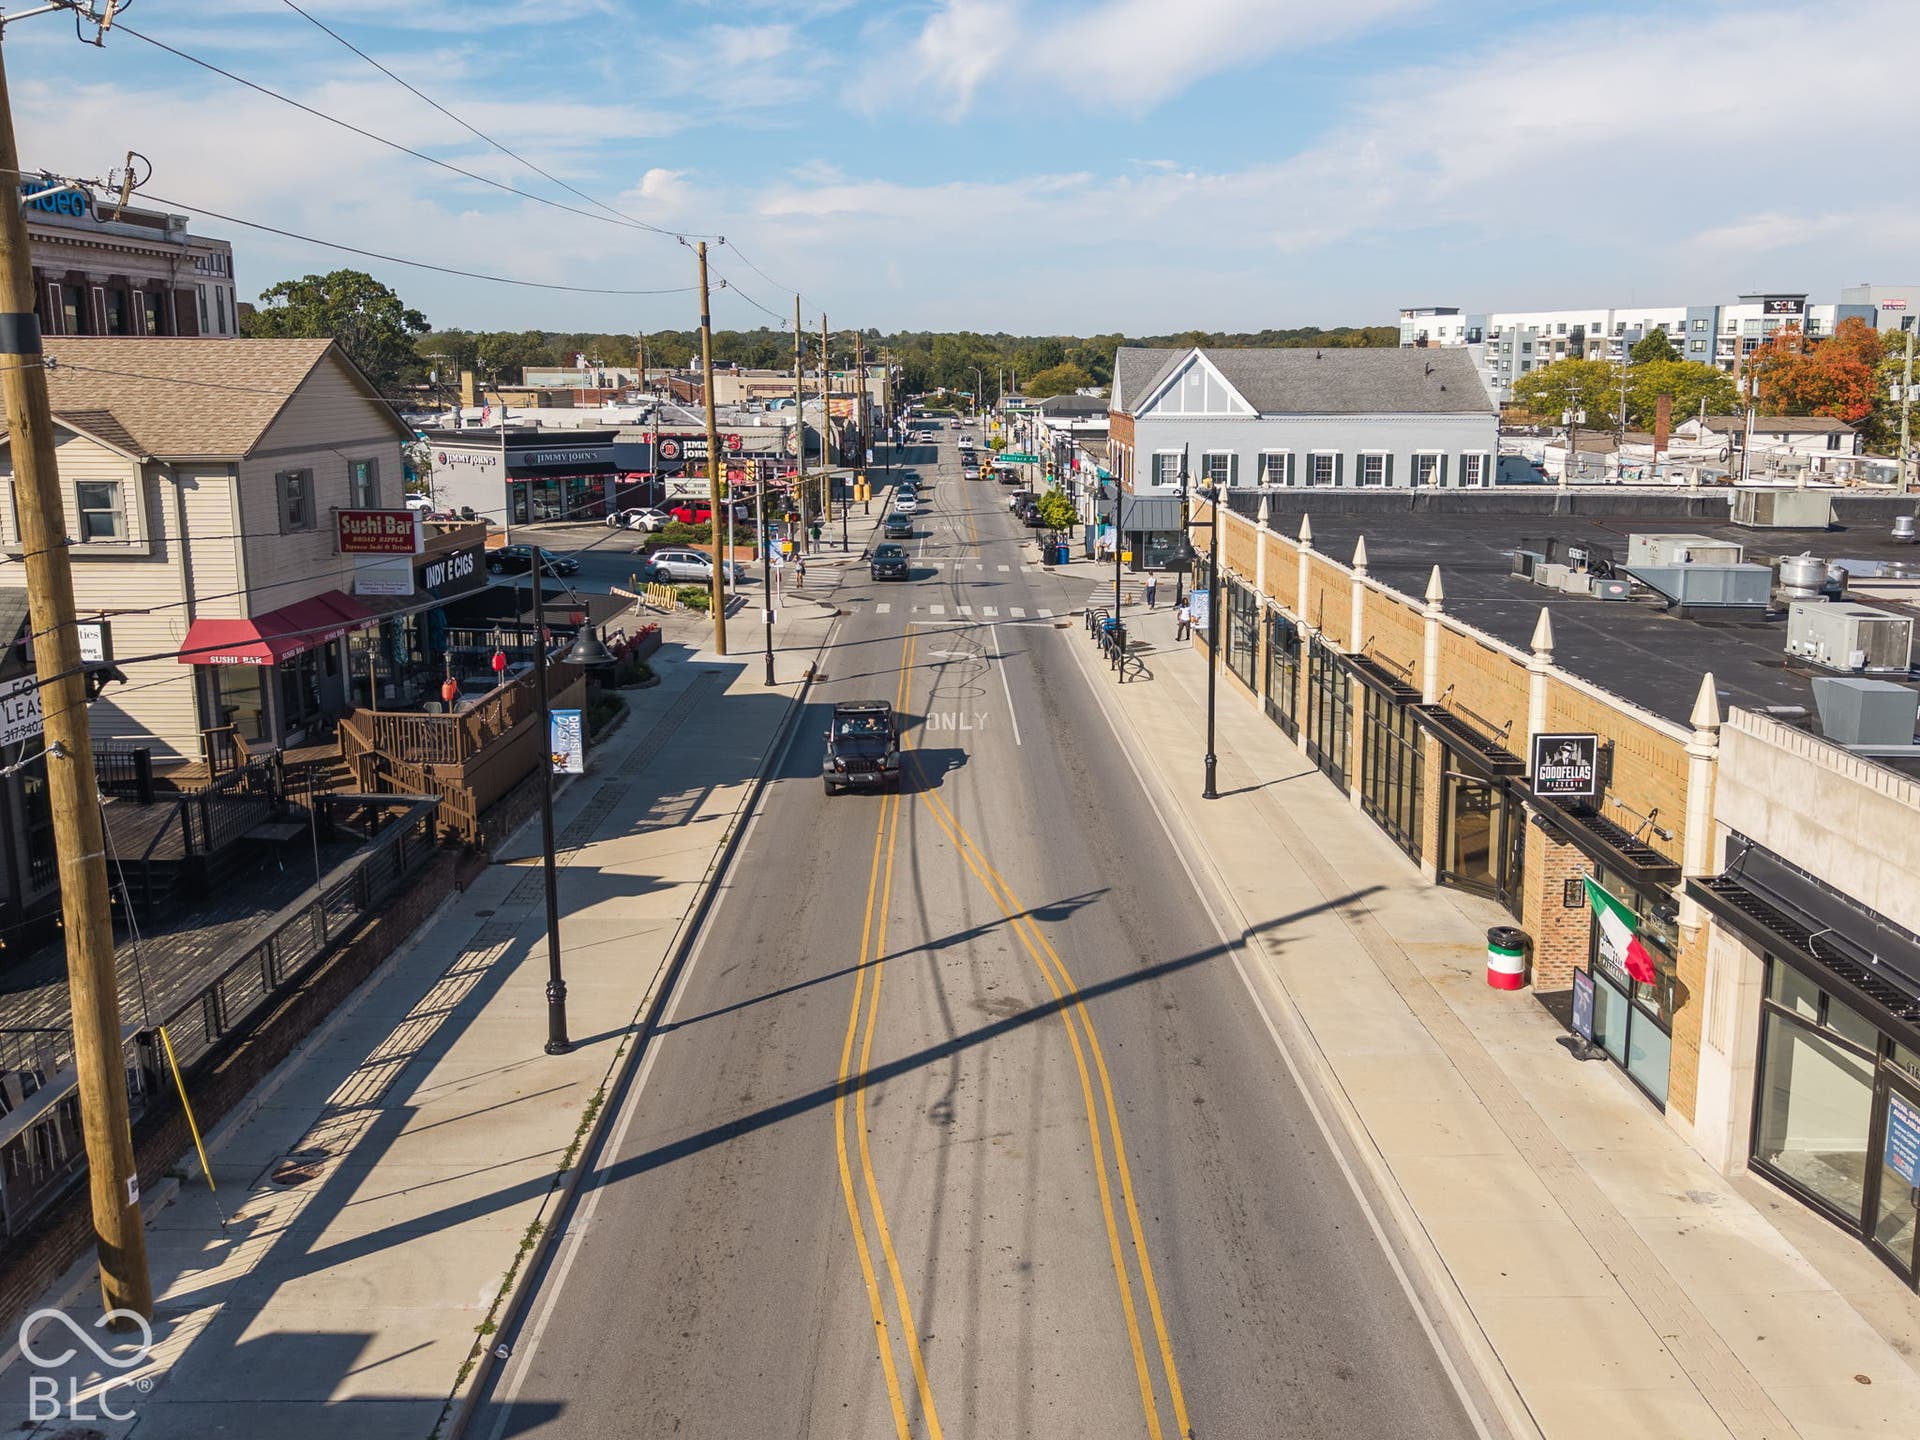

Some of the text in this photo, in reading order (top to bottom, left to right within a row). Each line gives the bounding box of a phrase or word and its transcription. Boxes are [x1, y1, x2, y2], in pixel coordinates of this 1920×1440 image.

[683, 440, 709, 450] JIMM
[447, 454, 496, 467] JIMMY JOHN'S
[537, 451, 598, 464] JIMMY JOHN'S
[683, 450, 709, 460] JOHN
[341, 515, 412, 535] Sushi Bar
[426, 562, 446, 589] INDY
[447, 559, 454, 581] E
[454, 552, 474, 579] CIGS
[210, 656, 263, 664] SUSHI BAR
[6, 696, 42, 724] LEAS
[925, 712, 989, 730] ONLY
[1539, 766, 1591, 780] GOODFELLAS
